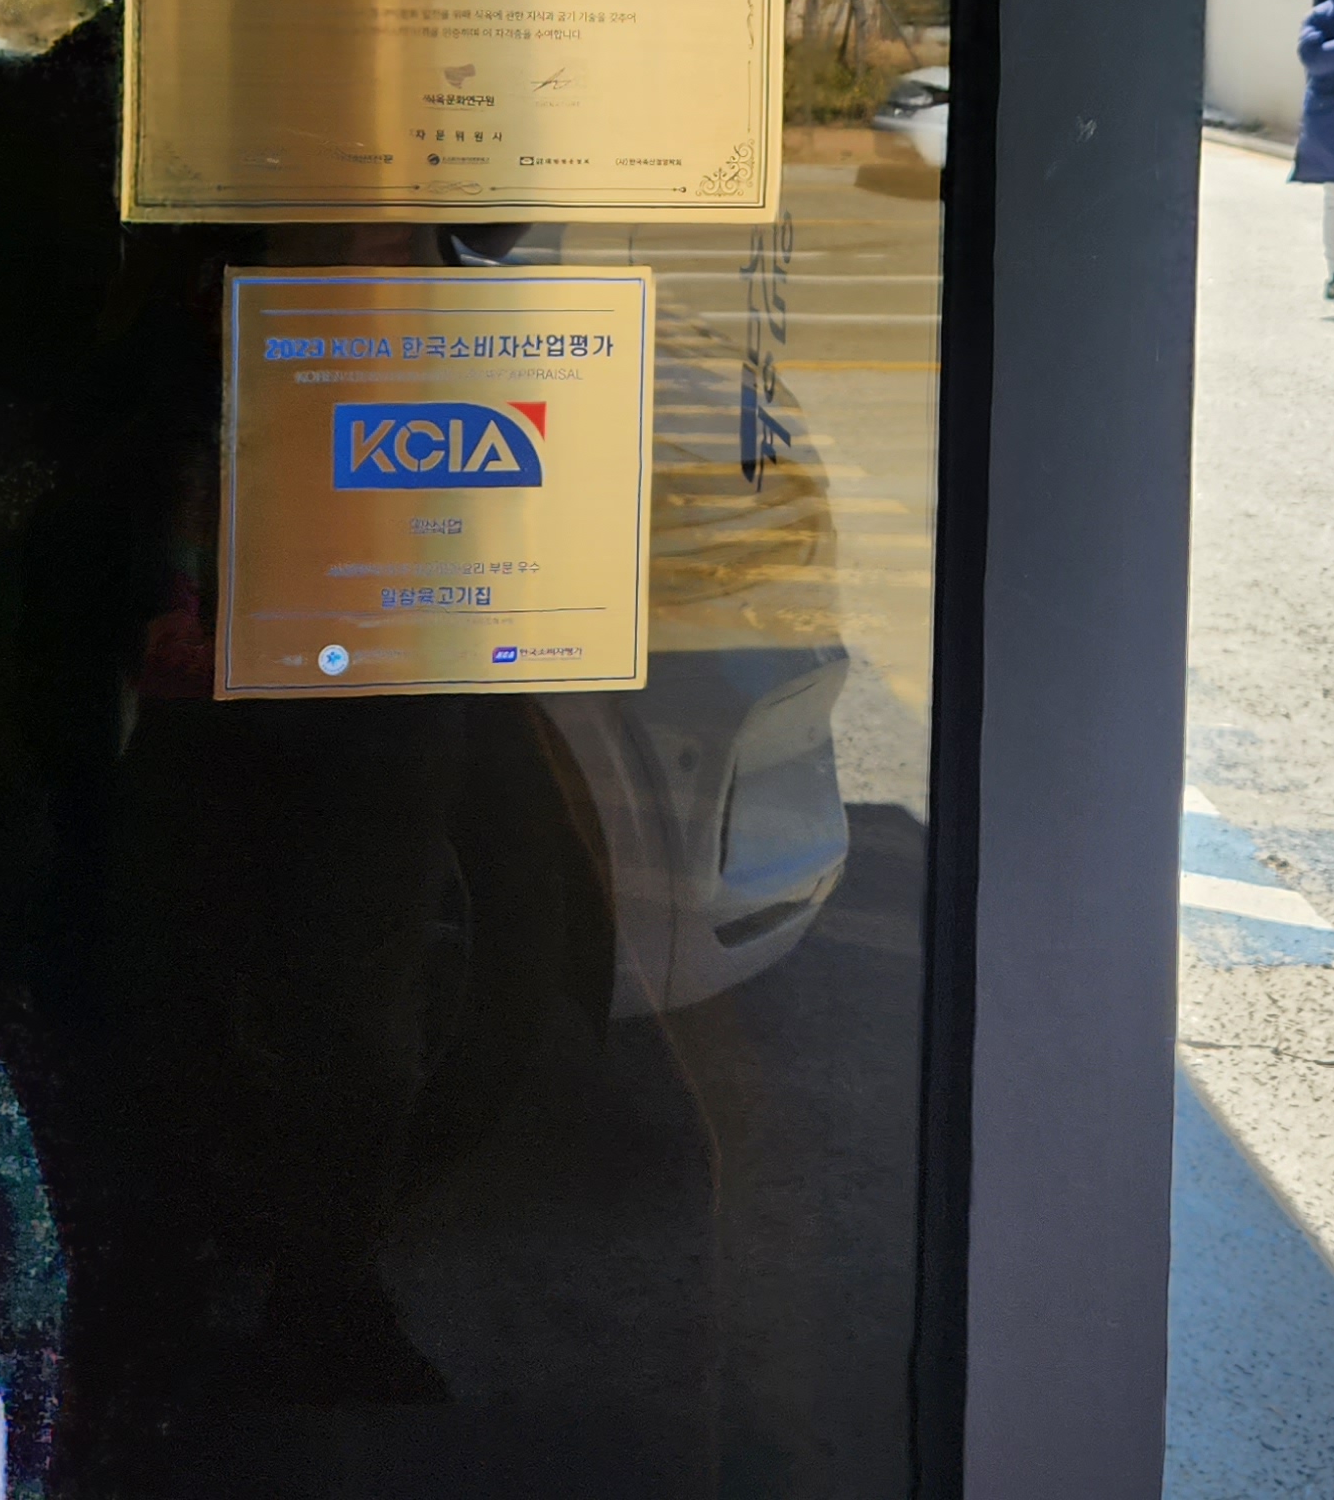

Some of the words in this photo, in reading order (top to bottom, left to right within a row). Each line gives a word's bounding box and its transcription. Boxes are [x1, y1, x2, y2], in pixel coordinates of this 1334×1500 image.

[526, 11, 555, 22] 지식과
[402, 332, 615, 361] 한국소비자산업평가
[350, 418, 522, 474] KCIA
[489, 561, 514, 576] 부문
[517, 561, 541, 575] 우수
